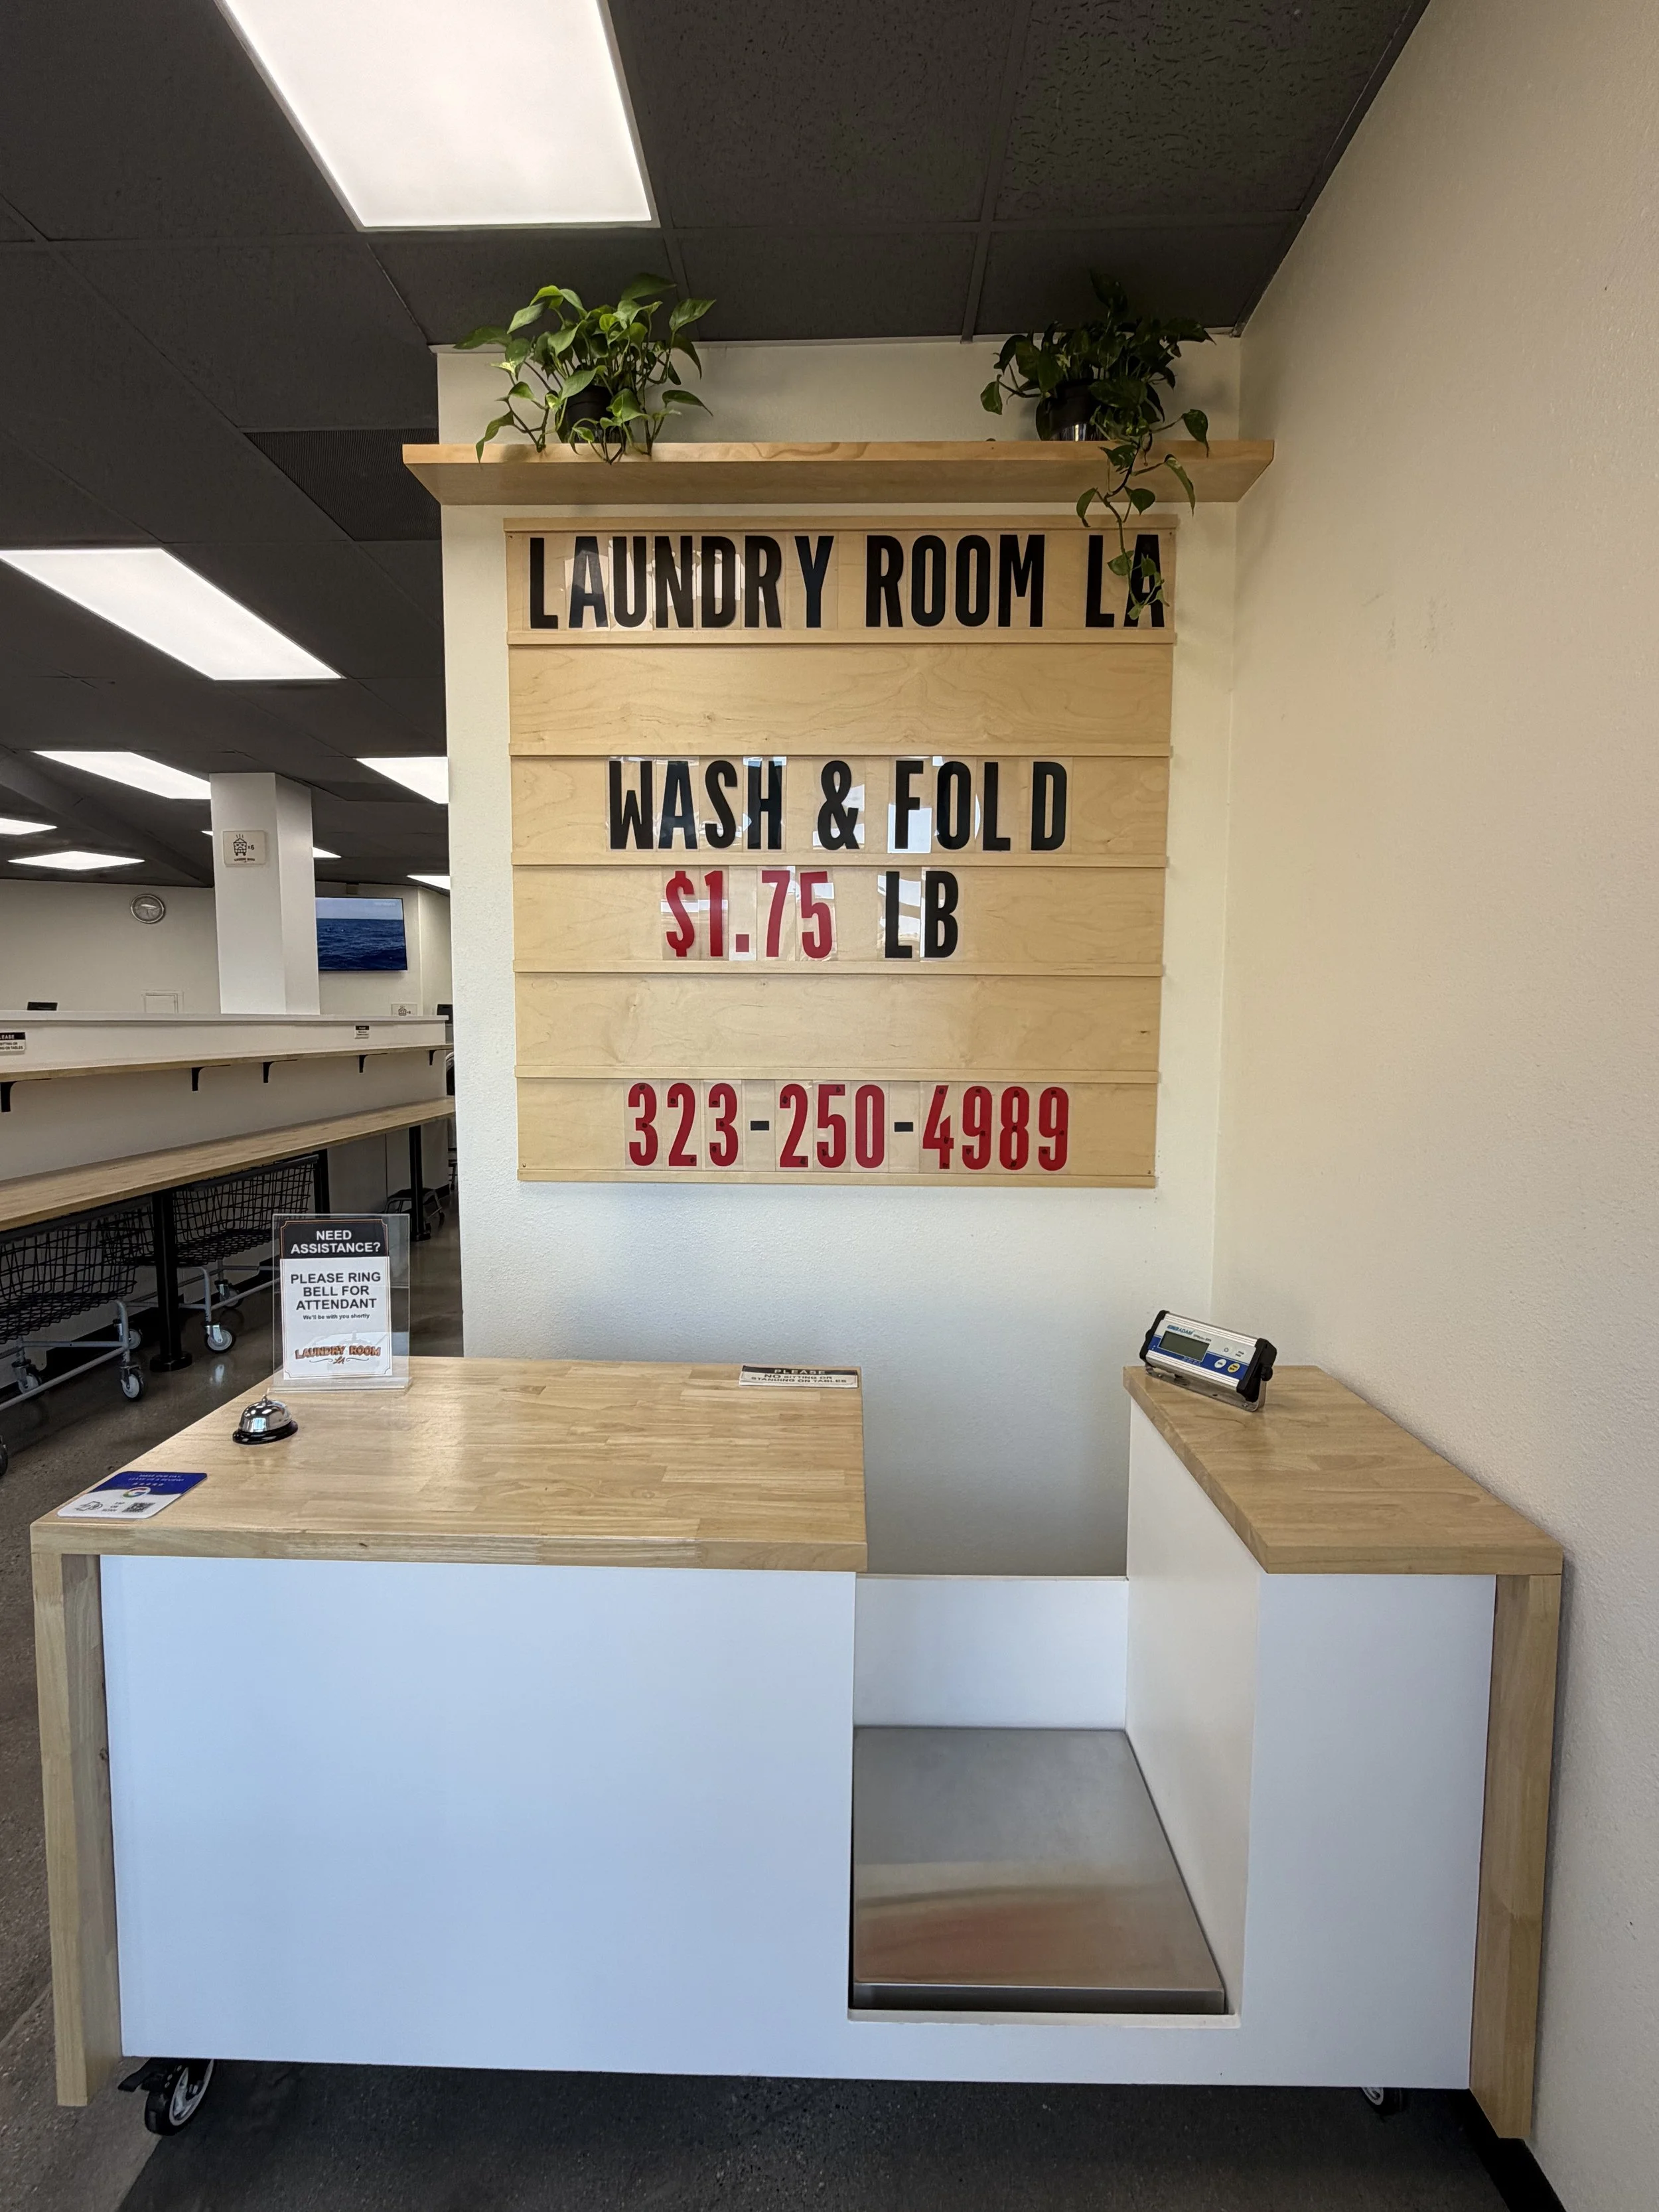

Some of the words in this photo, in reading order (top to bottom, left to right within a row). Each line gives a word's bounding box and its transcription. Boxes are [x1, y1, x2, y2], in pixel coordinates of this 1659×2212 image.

[530, 535, 834, 628] LAUNDRY
[866, 534, 1045, 627] ROOM
[1086, 534, 1165, 627] LA
[609, 760, 783, 849] WASH
[817, 760, 859, 849] &
[895, 761, 1067, 851] FOLD
[666, 870, 832, 958] $1.75
[885, 871, 959, 958] LB
[628, 1082, 1070, 1171] 323-250-4989
[316, 1230, 352, 1240] NEED
[290, 1242, 381, 1254] ASSISTANCE?
[291, 1272, 344, 1284] PLEASE
[348, 1272, 381, 1282] RING
[303, 1286, 338, 1297] BELL
[342, 1286, 370, 1295] FOR
[296, 1298, 377, 1310] ATTENDANT
[295, 1345, 346, 1359] LAUNDRY
[349, 1345, 382, 1357] ROOM
